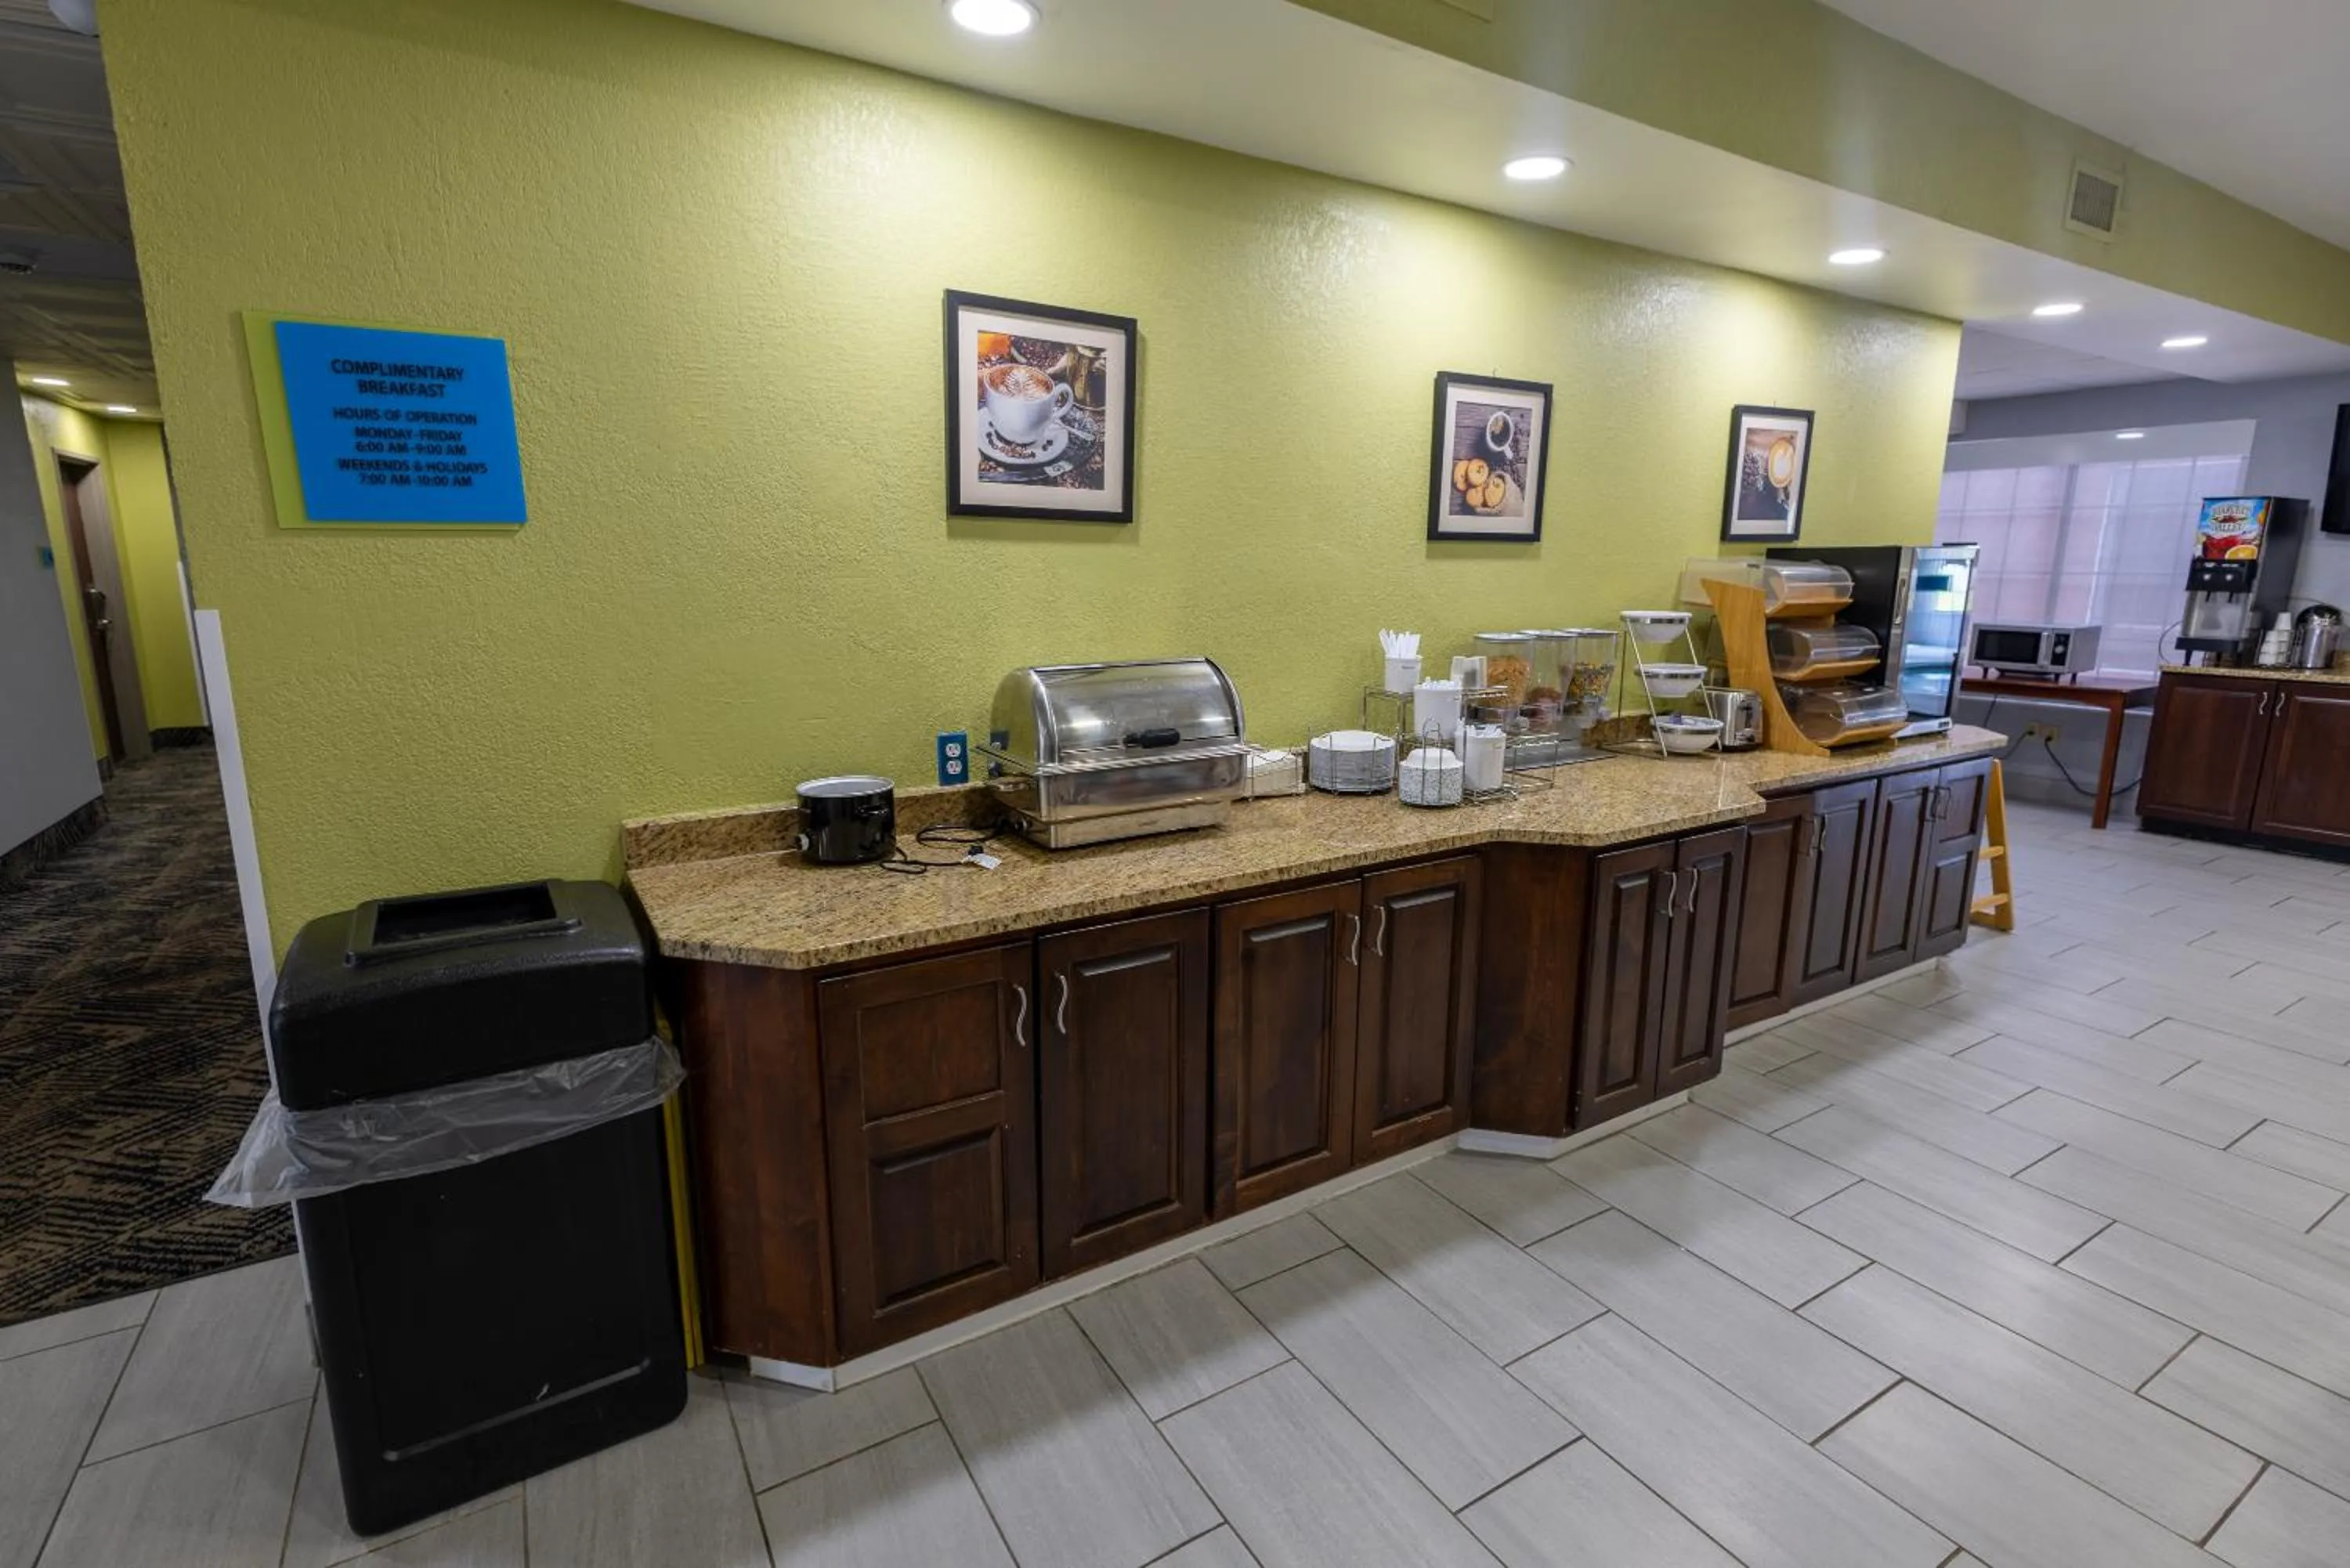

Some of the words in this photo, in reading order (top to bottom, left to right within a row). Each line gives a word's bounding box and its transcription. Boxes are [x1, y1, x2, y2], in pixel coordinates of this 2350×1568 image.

[331, 358, 464, 382] COMPLIMENTARY
[357, 379, 446, 398] BREAKFAST
[333, 406, 381, 421] HOURS
[384, 408, 402, 421] OF
[406, 410, 477, 425] OPERATION
[356, 441, 385, 452] 6:00
[446, 443, 466, 455] AM
[338, 457, 411, 471] WEEKENDS
[426, 461, 489, 474] HOLIDAYS
[360, 472, 386, 485] 7:00
[453, 475, 472, 486] AM
